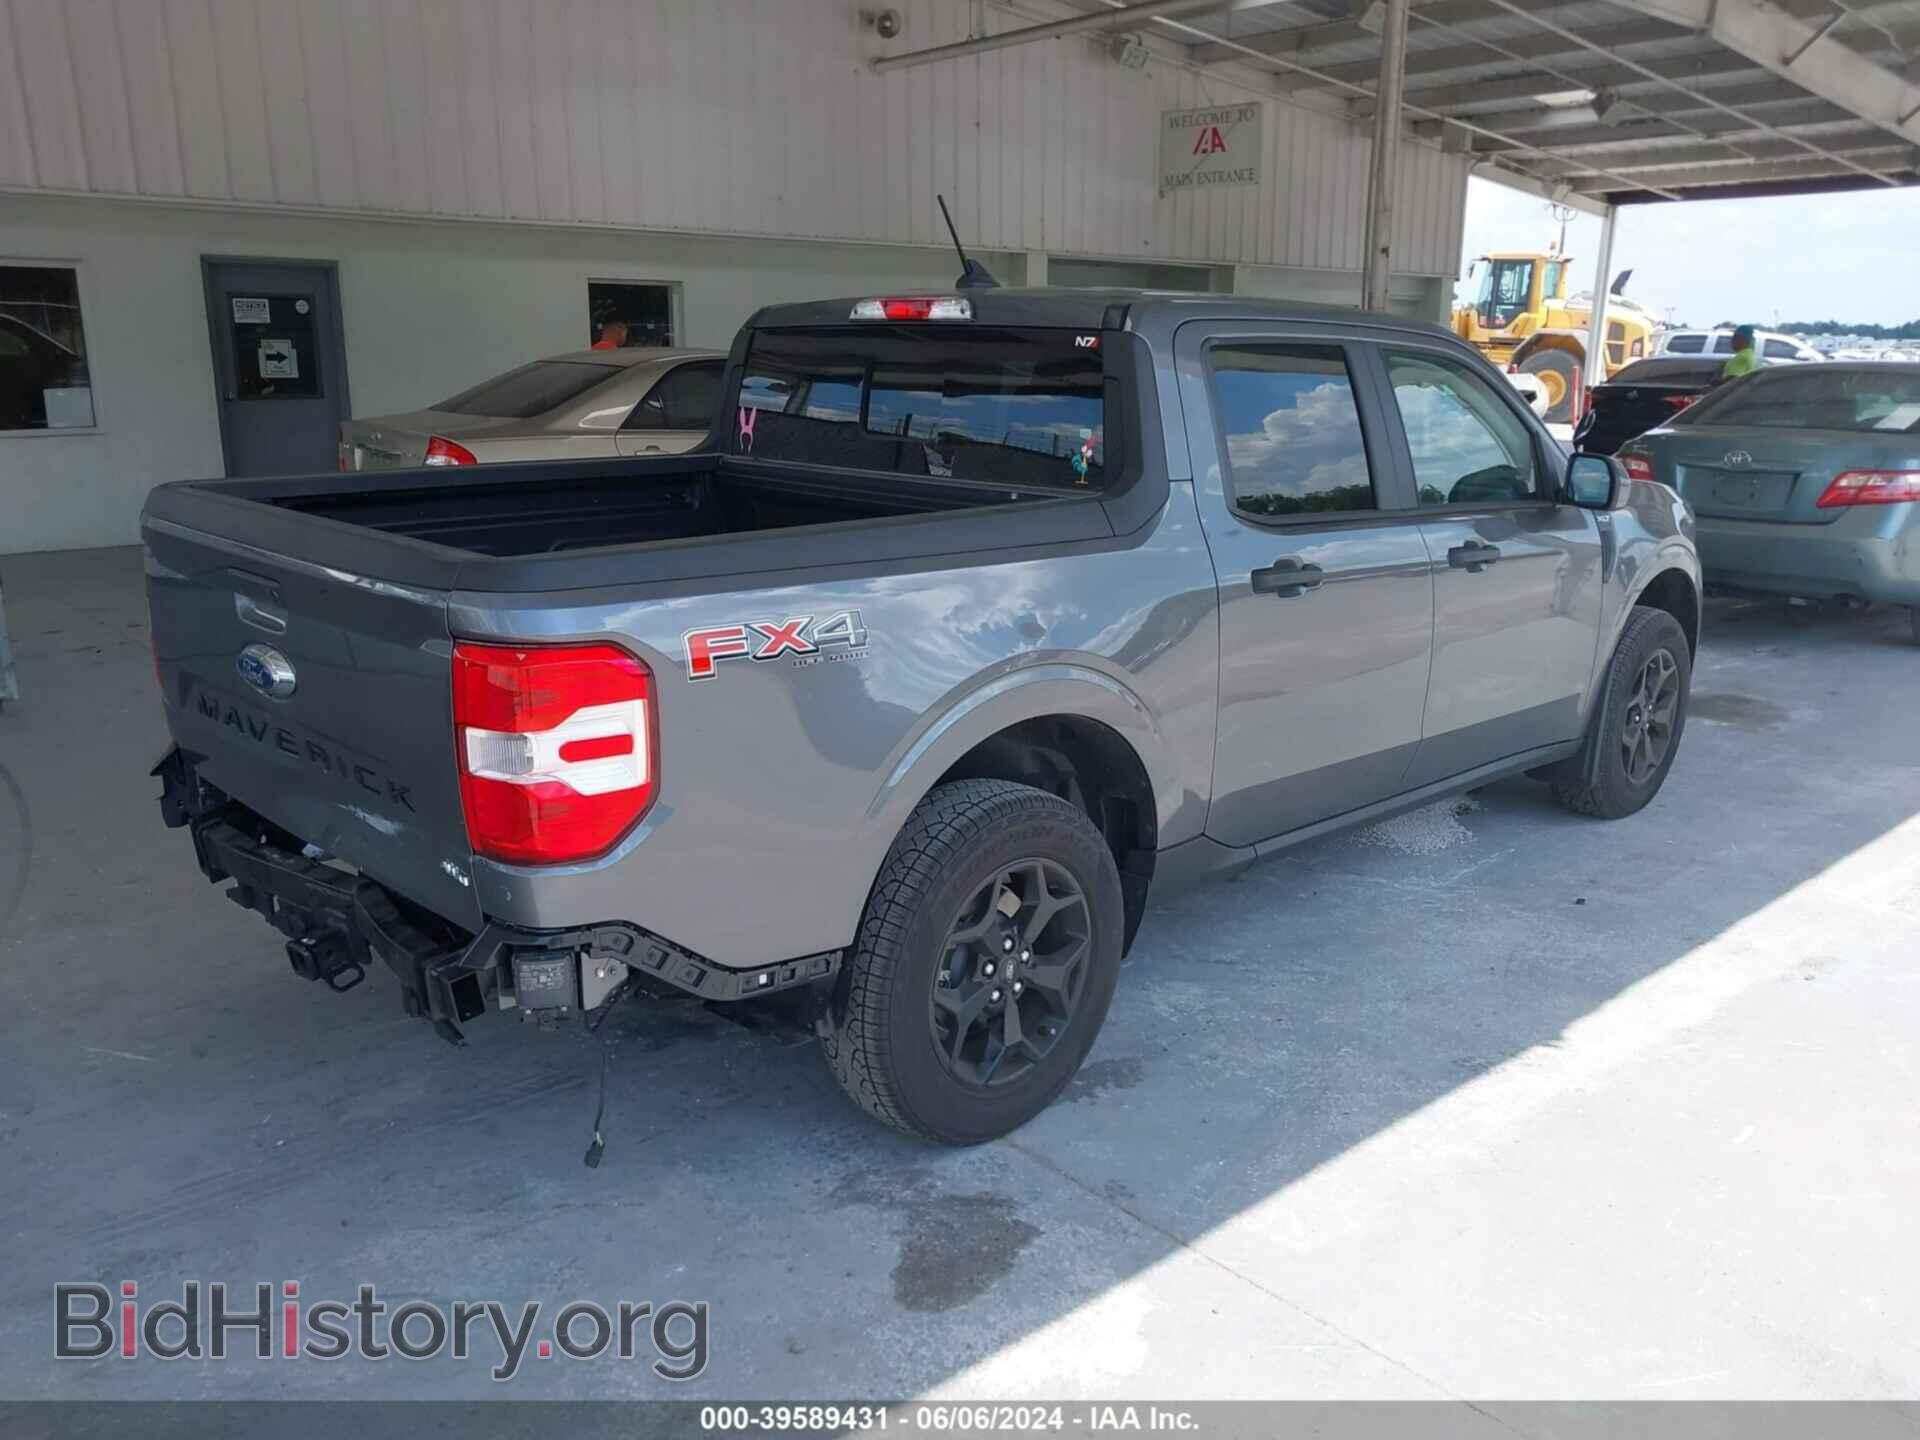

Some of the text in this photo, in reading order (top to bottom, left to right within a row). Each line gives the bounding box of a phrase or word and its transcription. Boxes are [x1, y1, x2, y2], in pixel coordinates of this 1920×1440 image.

[1168, 108, 1256, 128] WELCOME TO
[1197, 167, 1257, 184] ENTRANCE
[681, 608, 869, 682] FX4
[197, 694, 417, 813] MAVERICK
